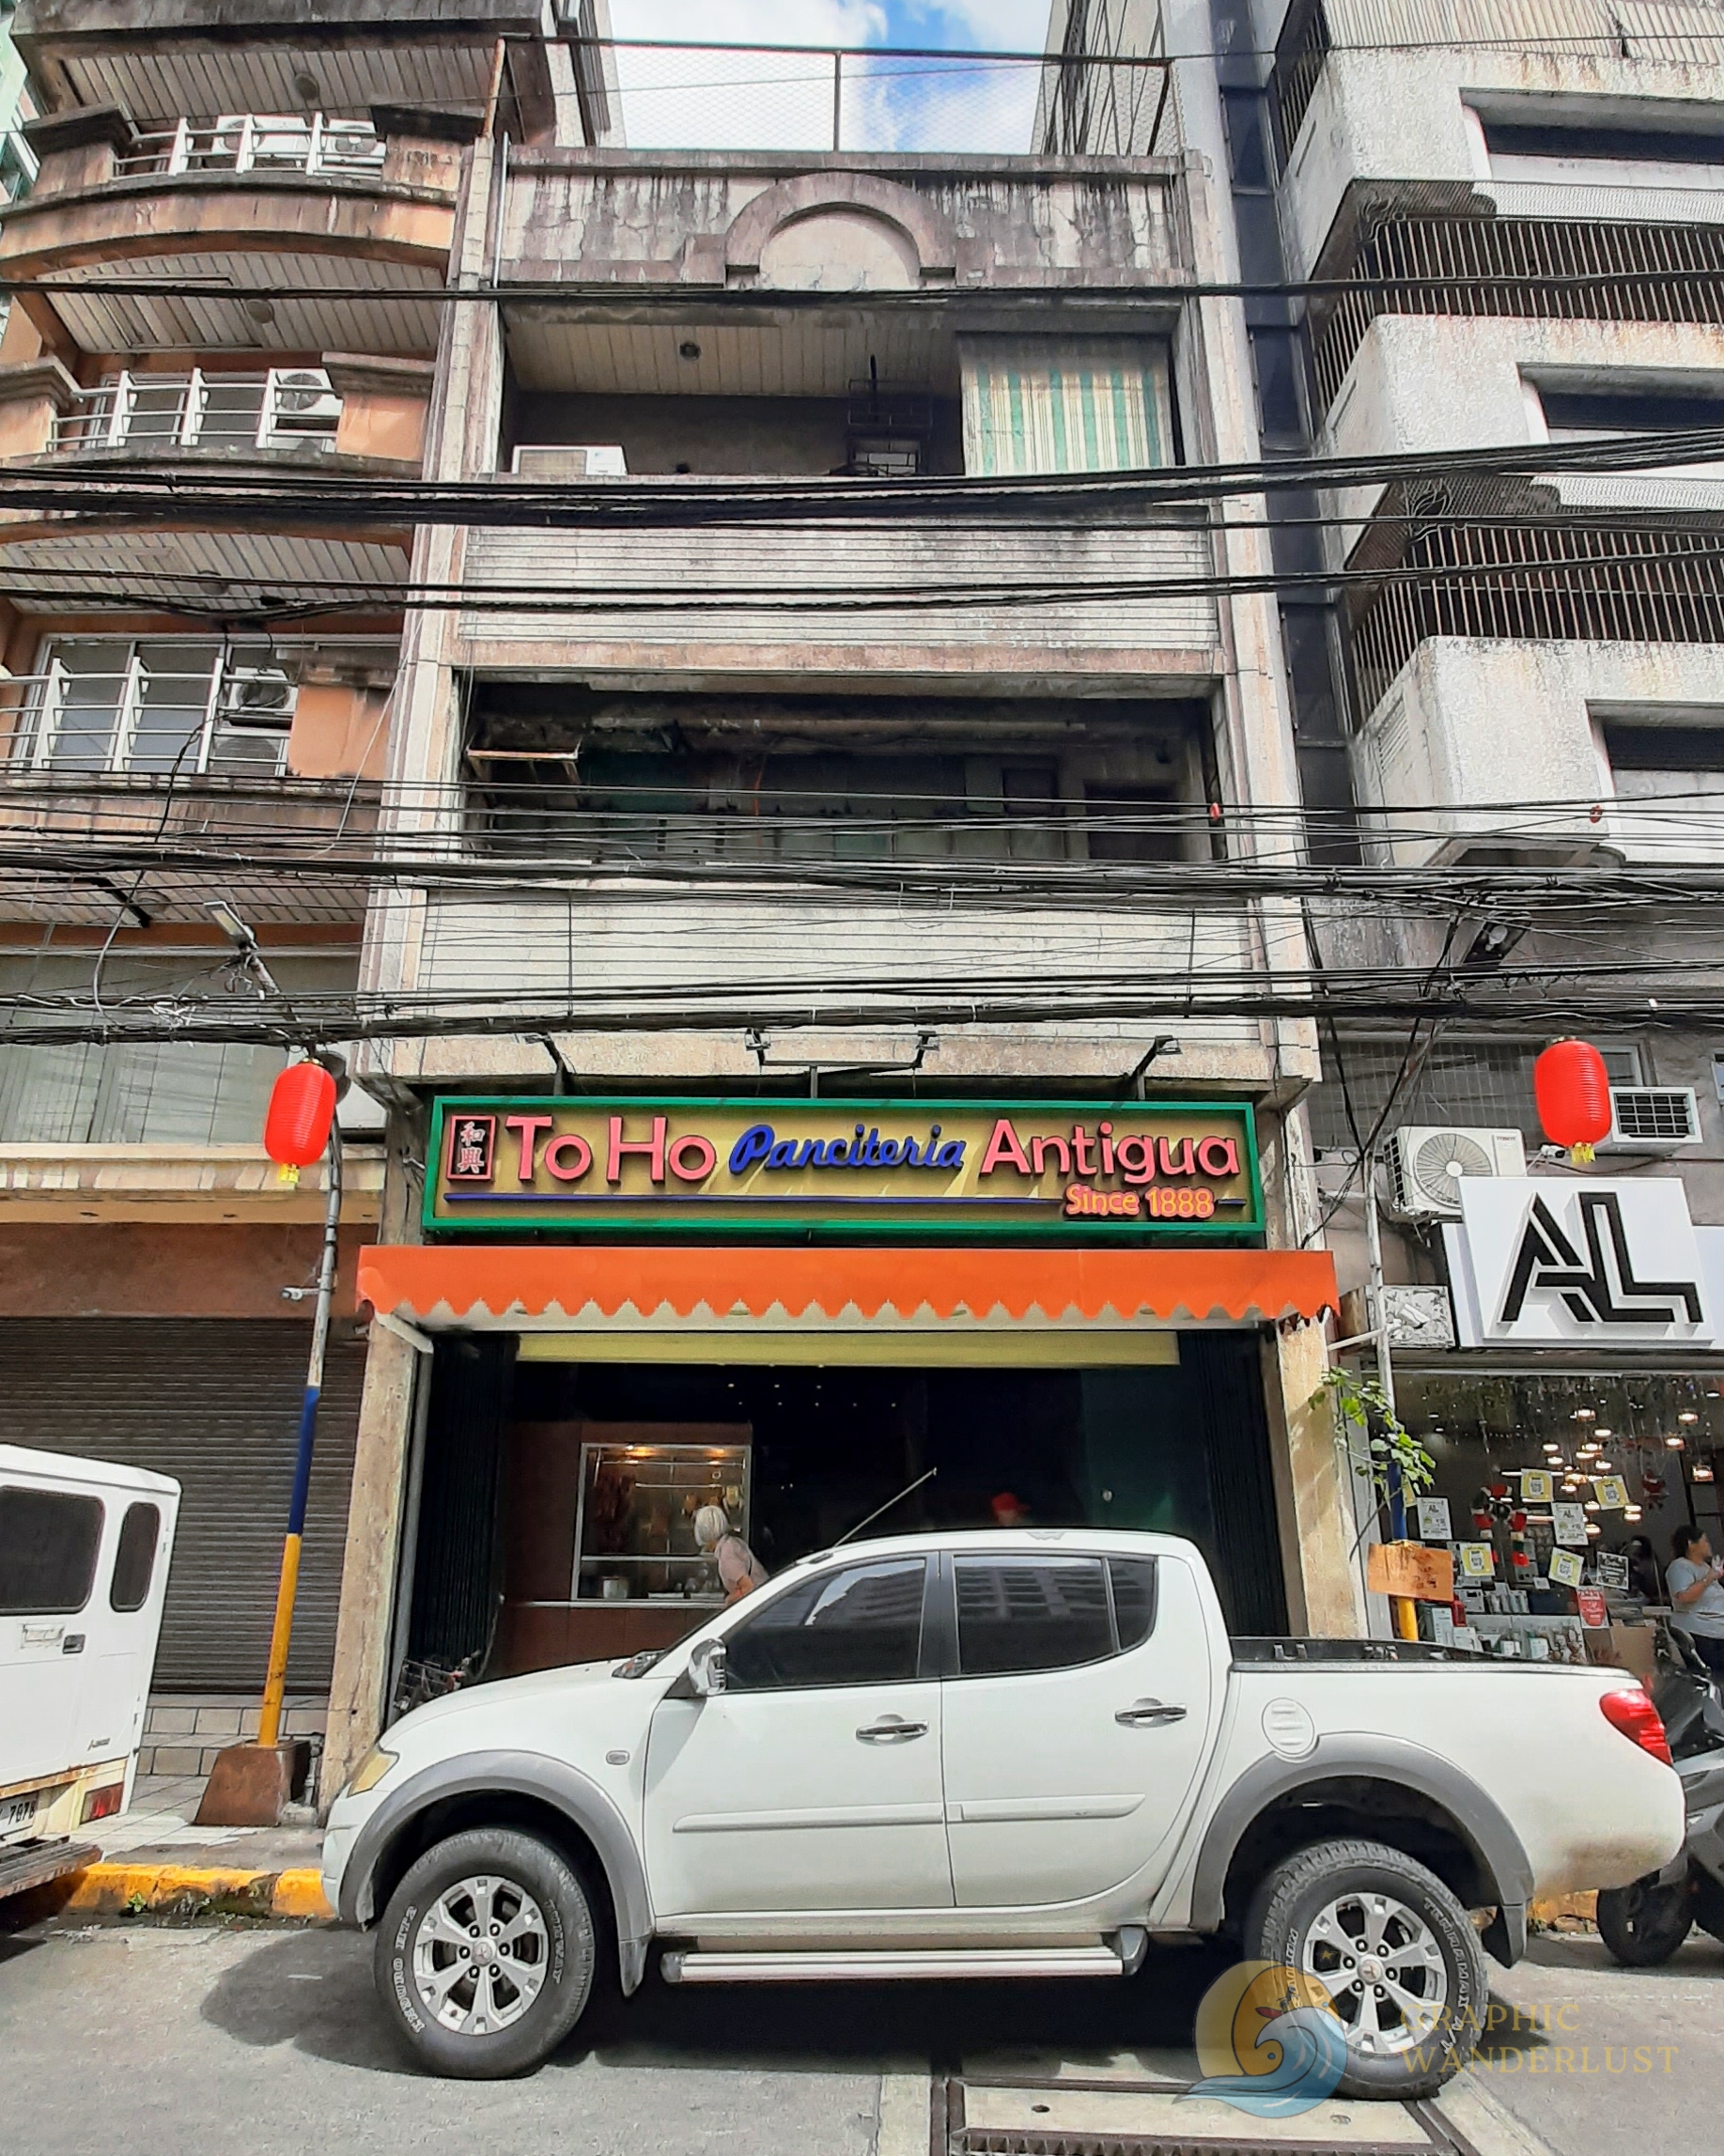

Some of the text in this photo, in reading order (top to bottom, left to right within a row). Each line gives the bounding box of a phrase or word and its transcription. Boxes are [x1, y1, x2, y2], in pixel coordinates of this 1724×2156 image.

[457, 1121, 486, 1174] 和興
[728, 1124, 966, 1174] Panciteria
[980, 1119, 1239, 1184] Antigua
[1064, 1182, 1215, 1218] Since 1888
